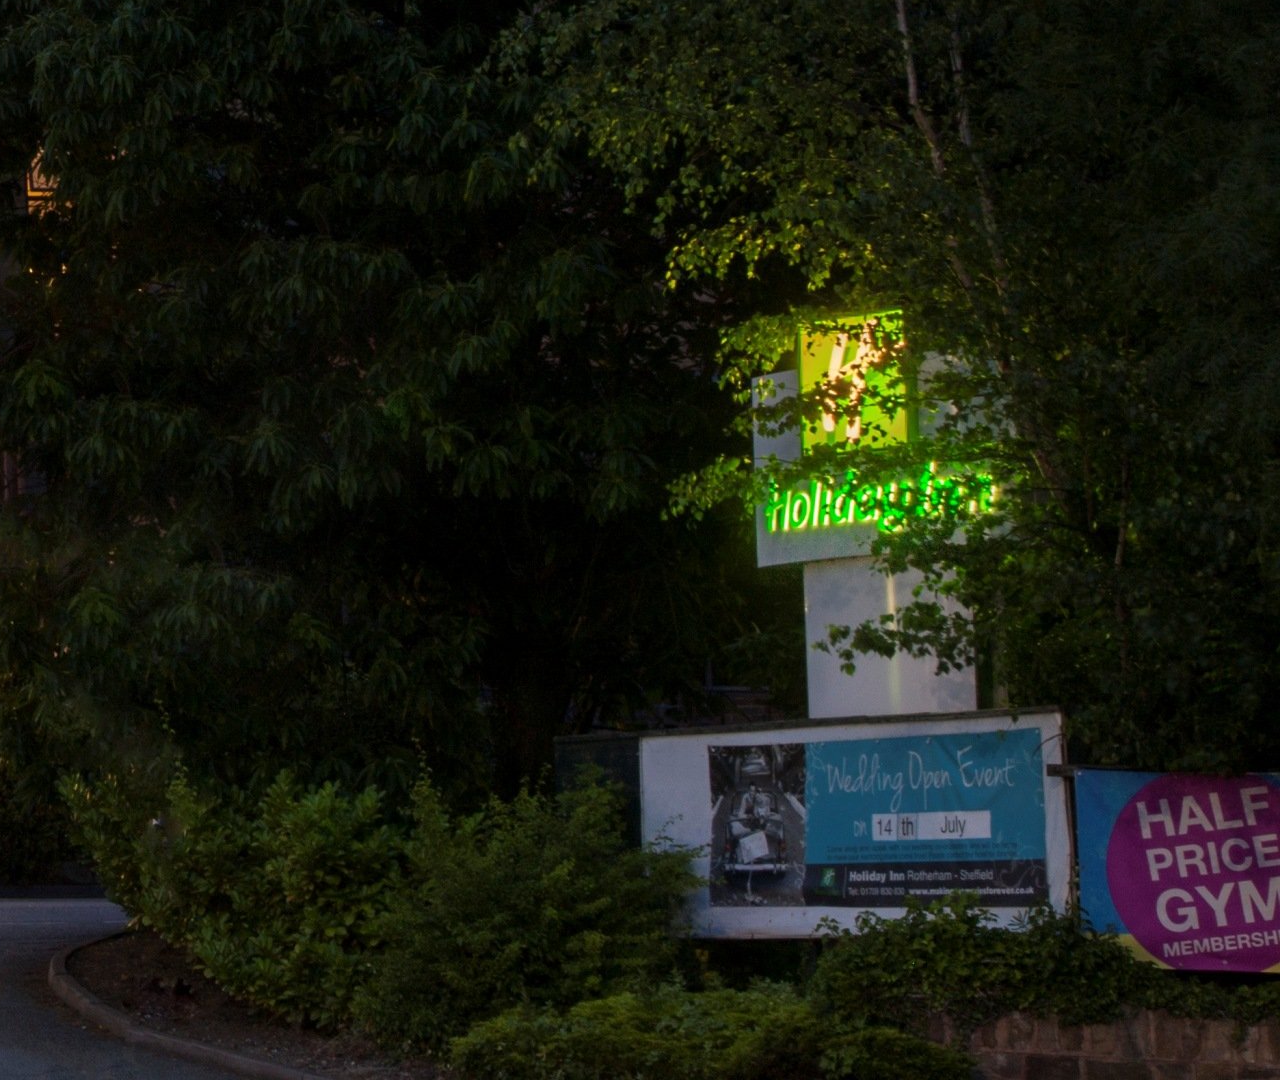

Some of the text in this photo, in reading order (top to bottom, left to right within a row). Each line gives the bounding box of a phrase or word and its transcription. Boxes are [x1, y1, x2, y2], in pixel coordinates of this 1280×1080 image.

[827, 745, 1015, 813] Wedding Open Event
[877, 818, 893, 836] 14
[901, 817, 915, 836] th
[940, 817, 967, 839] July
[1136, 786, 1270, 840] HALF
[849, 870, 886, 884] Holiday
[889, 870, 906, 881] Inn
[1145, 833, 1280, 882] PRICE
[1156, 876, 1280, 933] GYM
